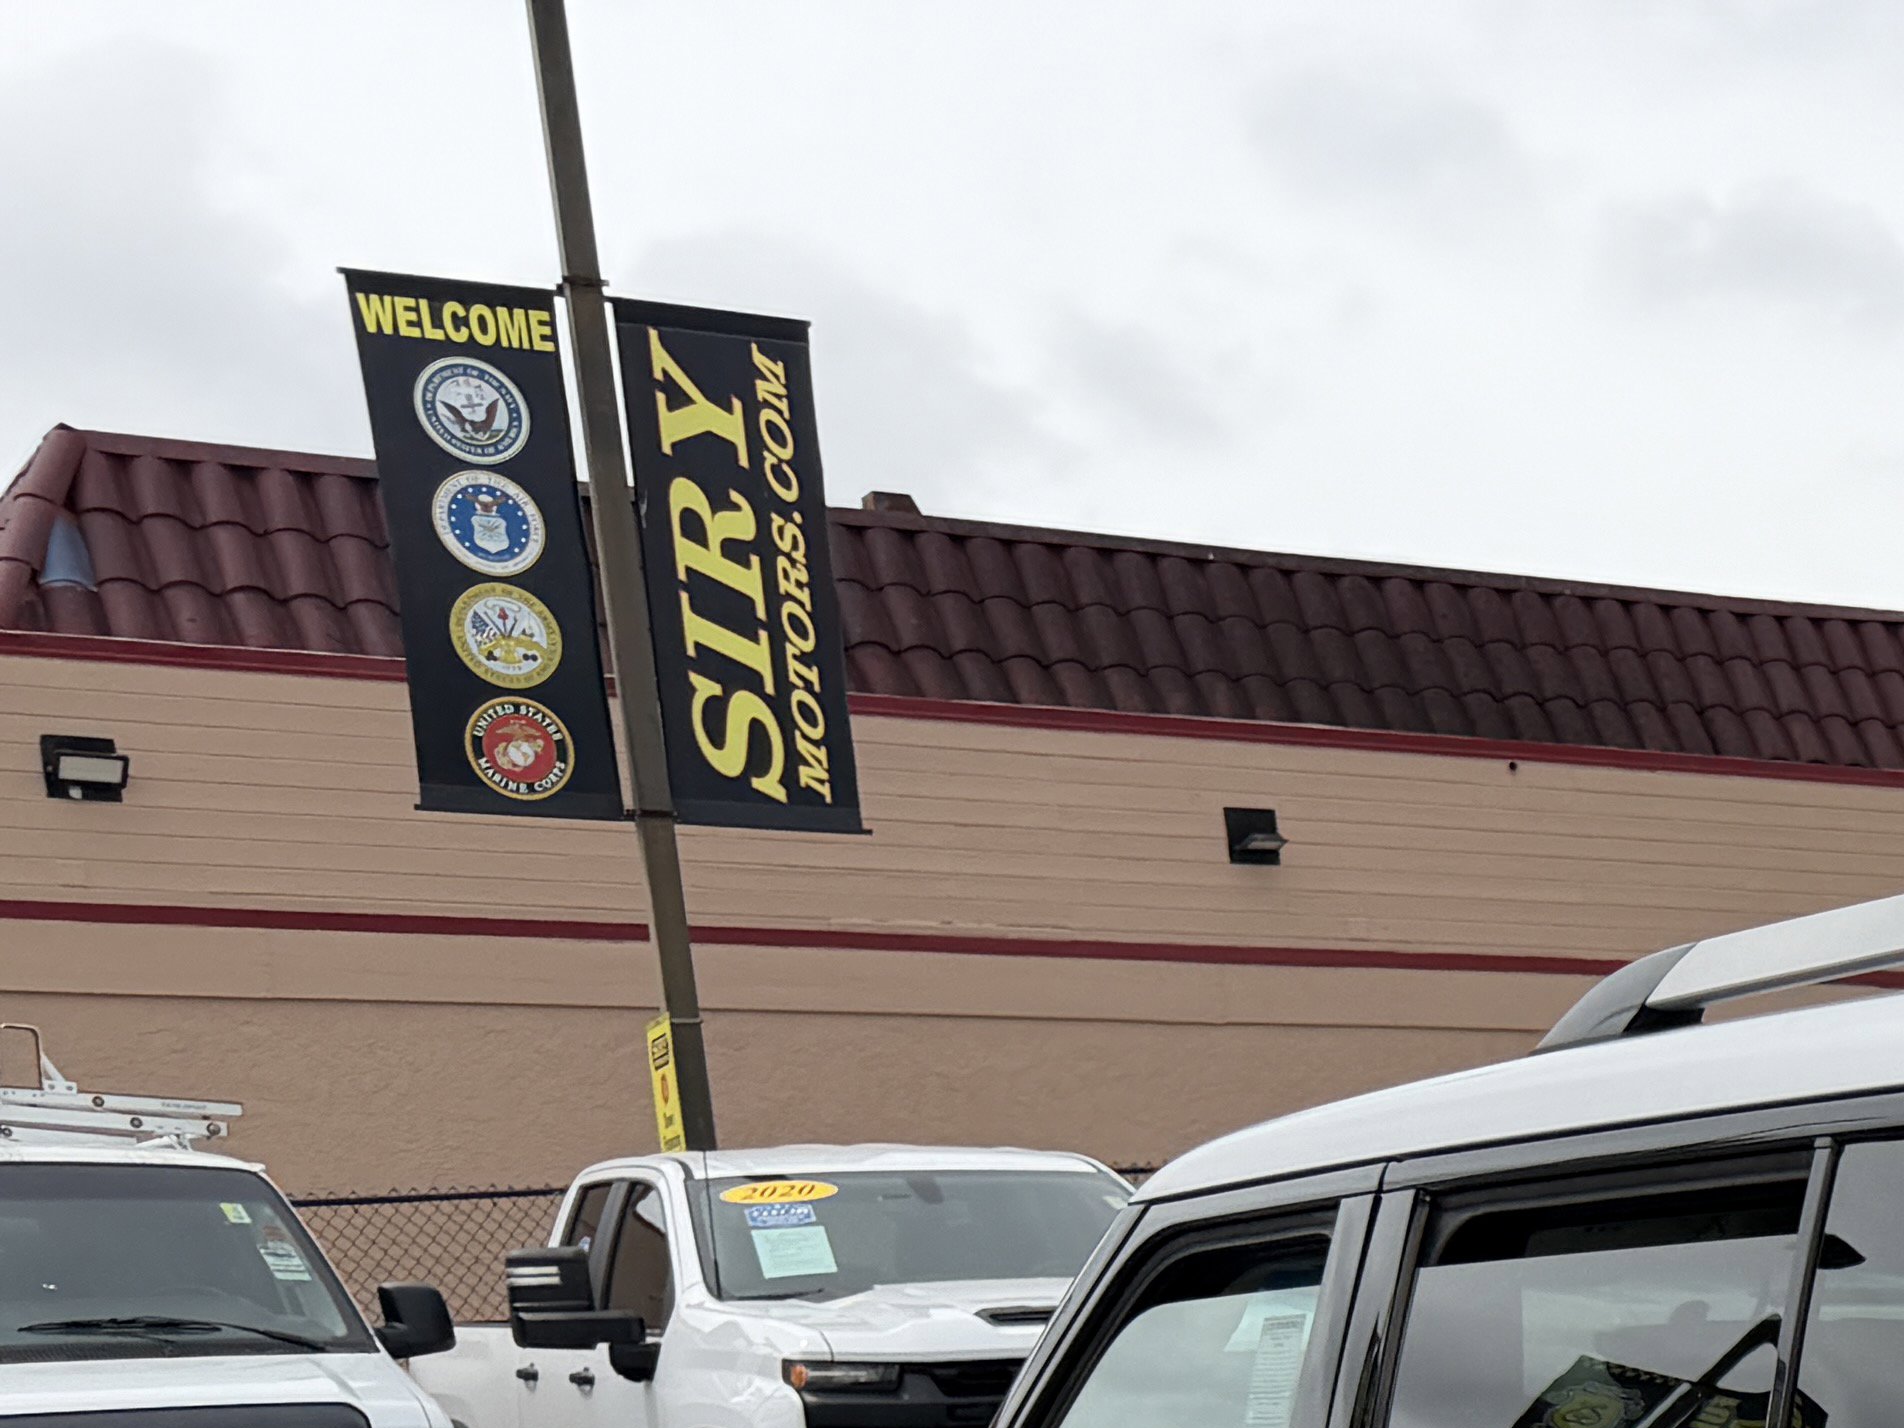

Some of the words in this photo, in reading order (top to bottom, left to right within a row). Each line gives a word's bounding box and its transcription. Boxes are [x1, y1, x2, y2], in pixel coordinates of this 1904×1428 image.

[356, 292, 556, 352] WELCOME
[647, 326, 787, 804] SIRY
[751, 342, 832, 804] MOTORS.COM
[472, 704, 515, 737] UNITED
[520, 705, 564, 741] STATES
[477, 756, 529, 794] MARINE
[741, 1183, 816, 1200] 2020
